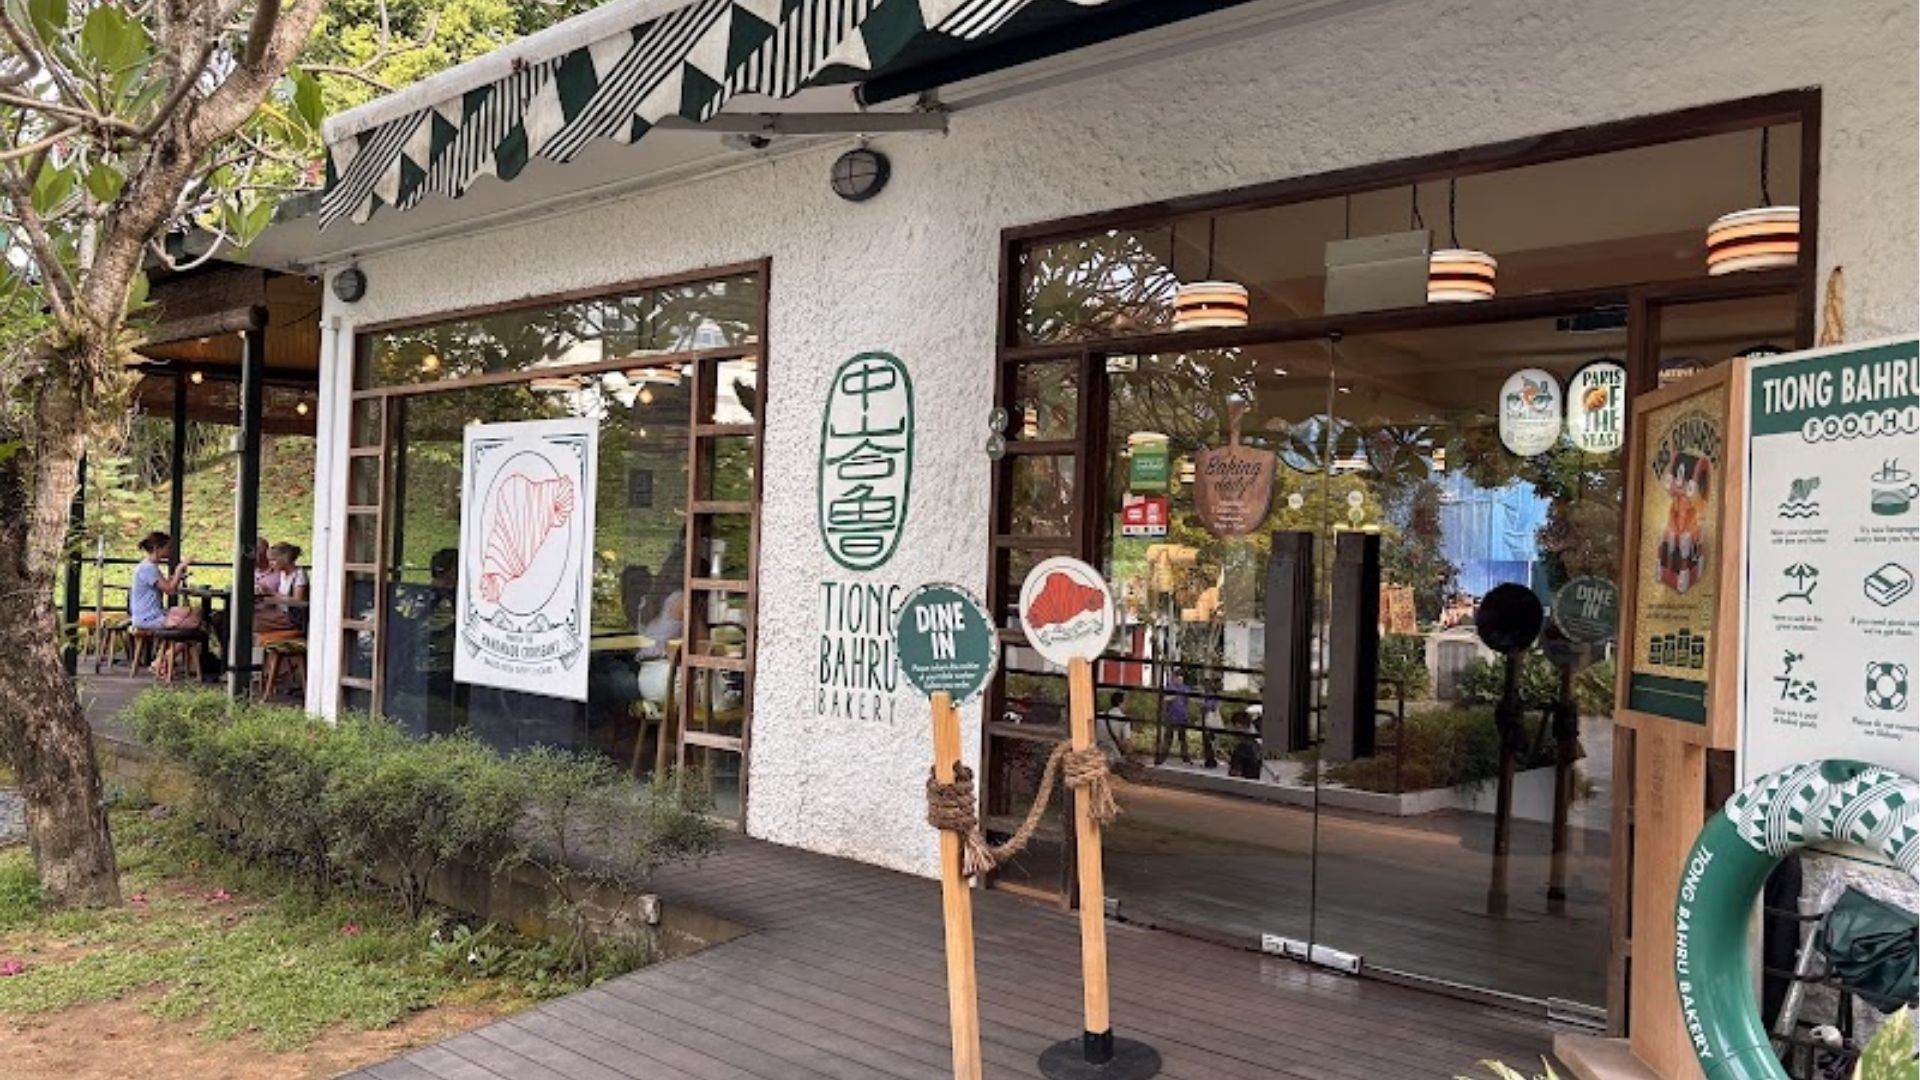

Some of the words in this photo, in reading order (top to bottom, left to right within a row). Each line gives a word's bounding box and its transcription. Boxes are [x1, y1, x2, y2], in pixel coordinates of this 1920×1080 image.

[1583, 369, 1622, 386] PARIS
[1763, 370, 1834, 414] TIONG
[1582, 433, 1620, 447] YEAST
[820, 581, 900, 642] TIONG
[1577, 584, 1613, 606] DINE
[1581, 602, 1600, 619] IN
[915, 602, 966, 633] DINE
[820, 635, 898, 693] BAHRU
[931, 631, 956, 660] IN
[817, 687, 896, 726] BAKERY
[1682, 845, 1714, 903] TIONG
[1676, 909, 1691, 971] BAHRU
[1677, 981, 1713, 1060] BAKERY
